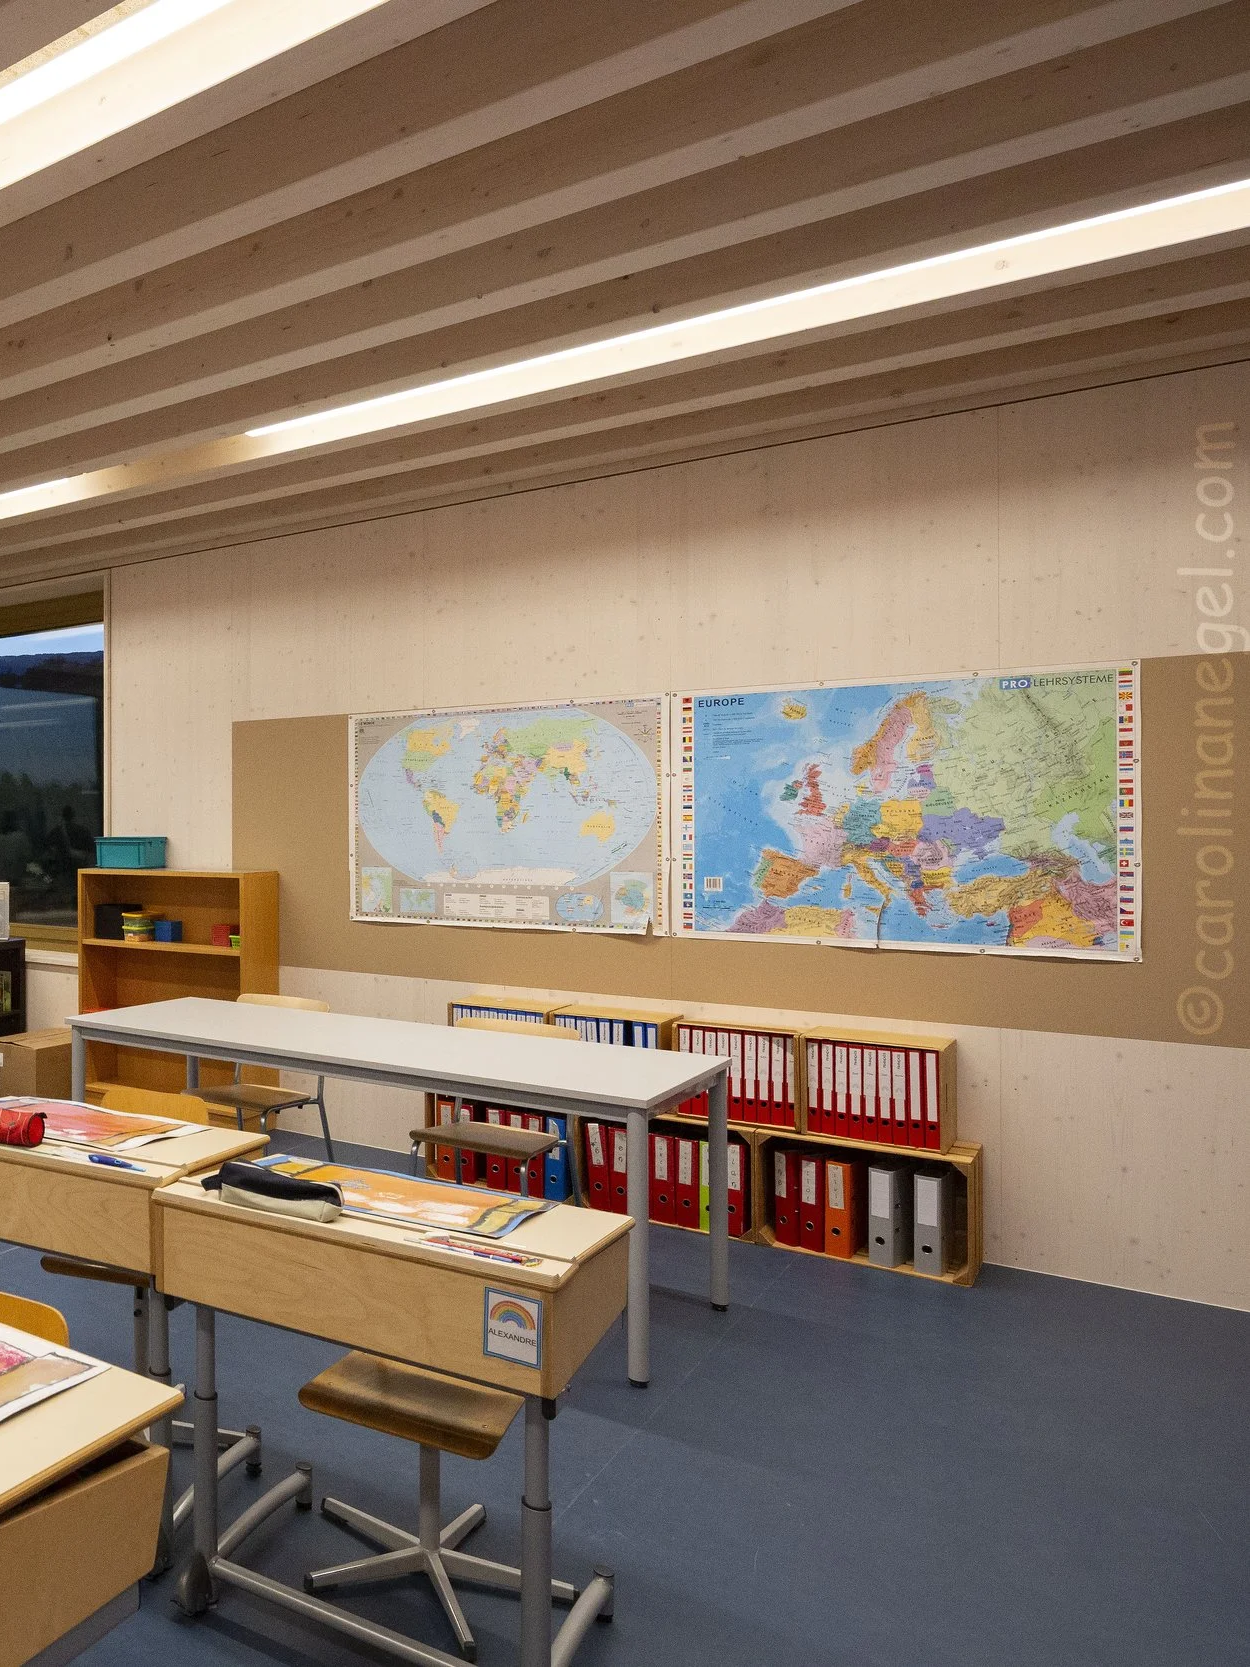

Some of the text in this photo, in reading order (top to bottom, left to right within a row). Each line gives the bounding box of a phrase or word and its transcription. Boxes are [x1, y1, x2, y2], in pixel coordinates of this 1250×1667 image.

[1002, 673, 1114, 689] PRO LEHRSYSTEME
[698, 697, 745, 708] EUROPE
[488, 1327, 537, 1347] ALEXANDRE
